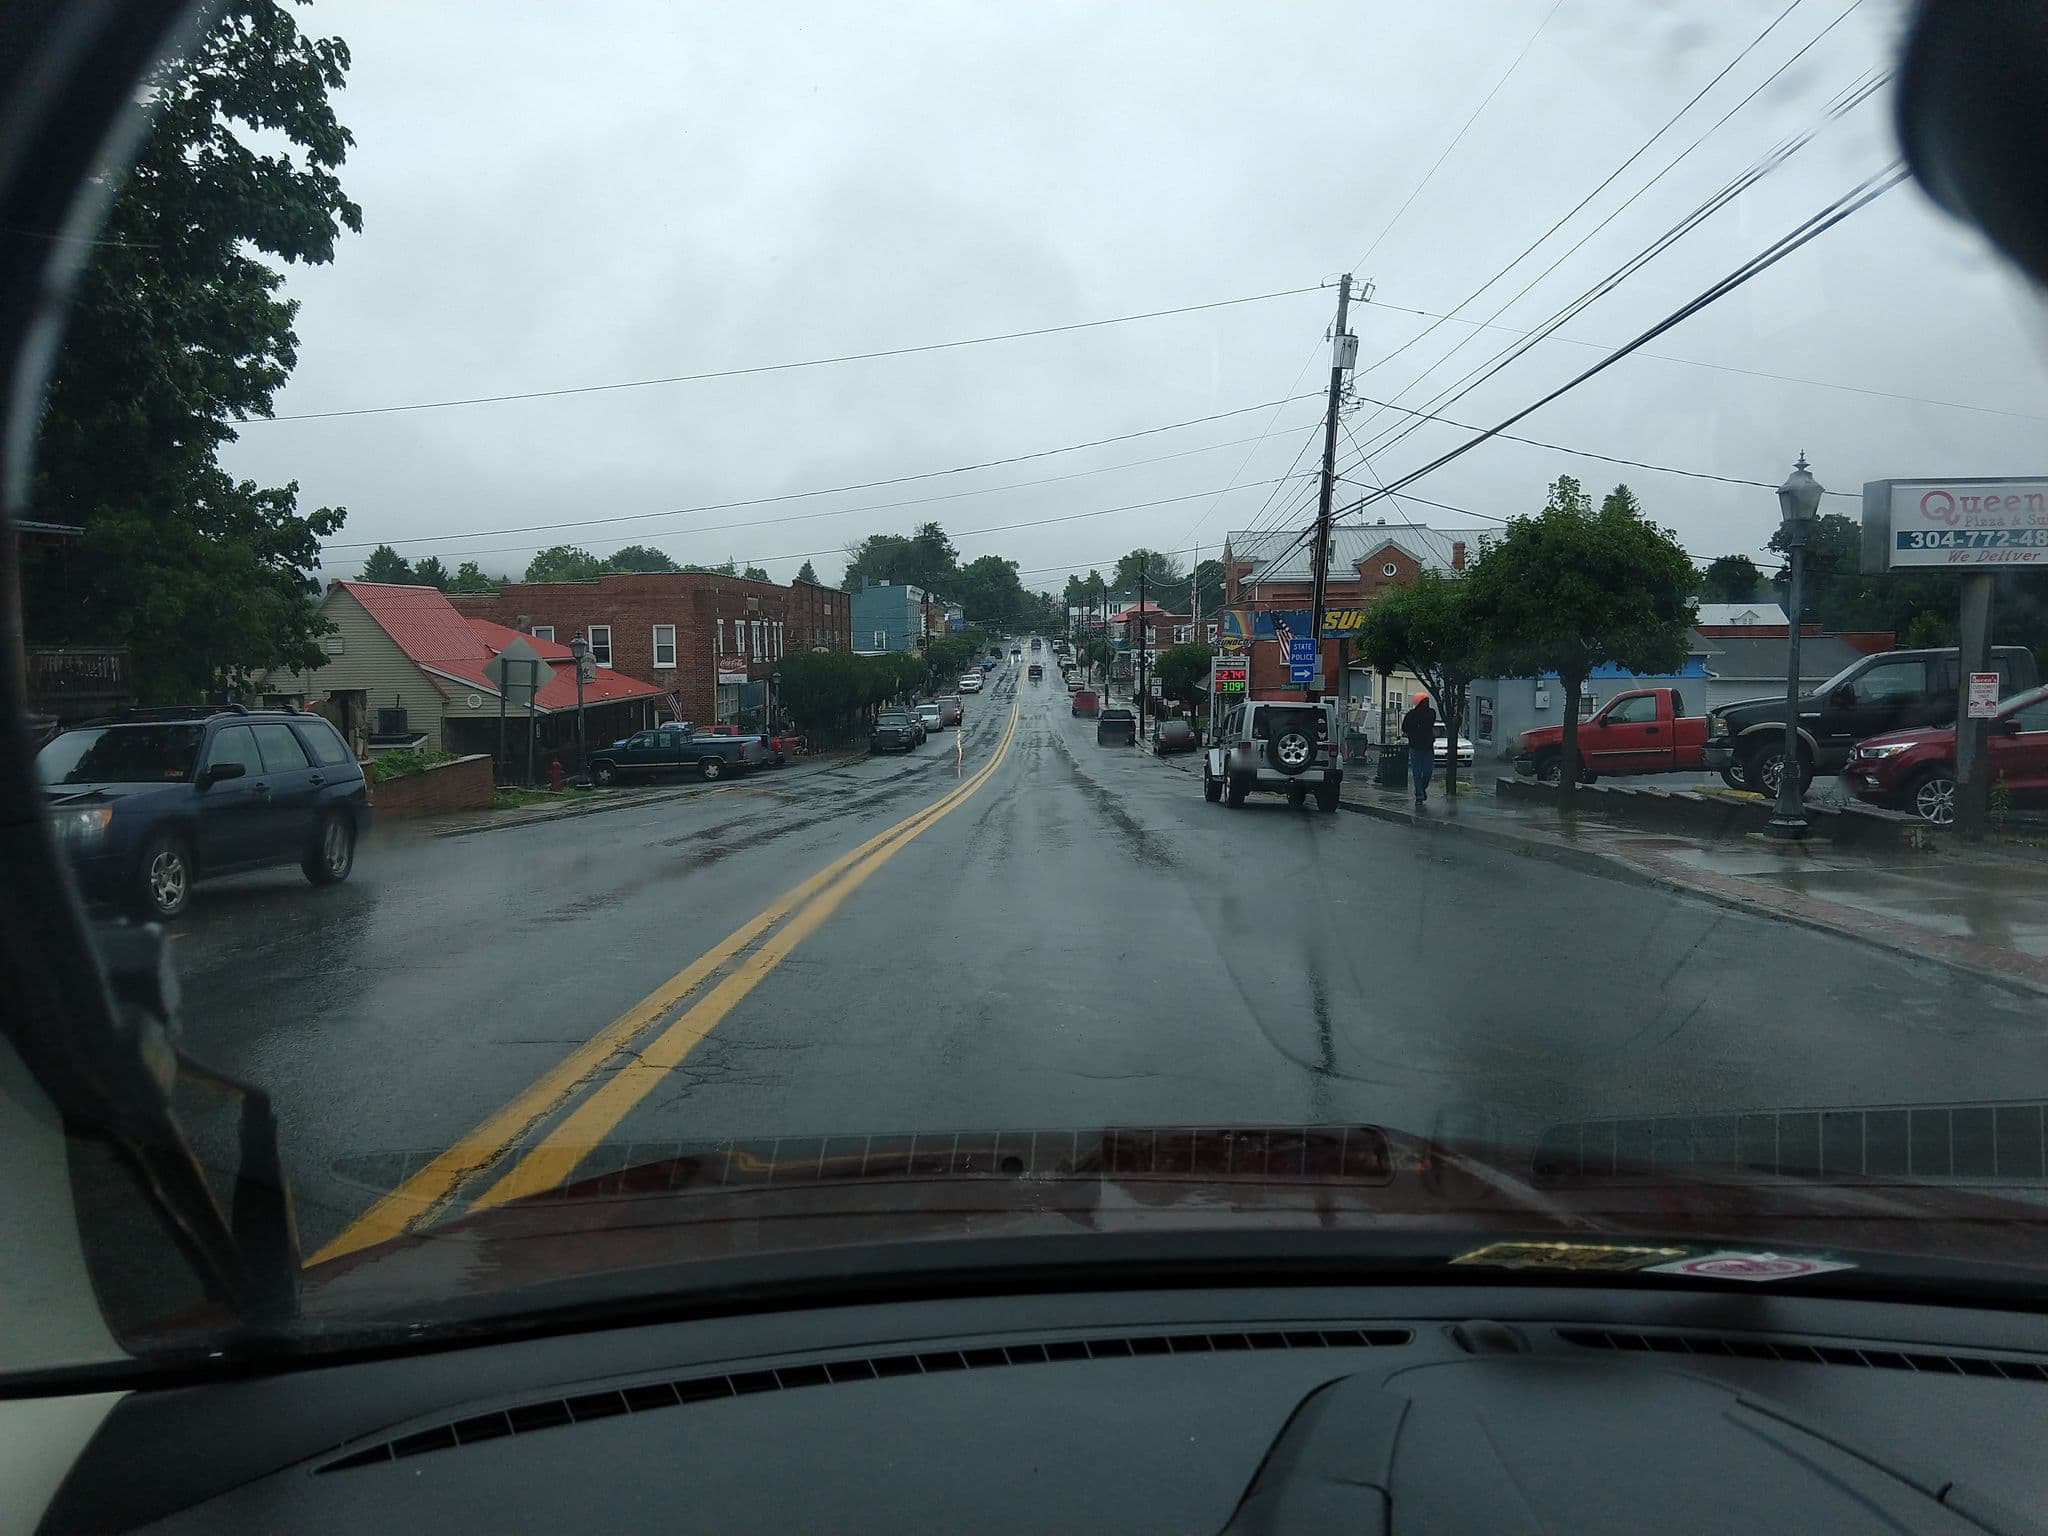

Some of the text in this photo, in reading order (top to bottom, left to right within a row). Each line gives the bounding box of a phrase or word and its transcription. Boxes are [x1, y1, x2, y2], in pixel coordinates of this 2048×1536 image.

[1965, 515, 2005, 528] Pizza
[1948, 550, 2041, 562] We Deliver
[1215, 639, 1252, 648] SUNOCO
[1291, 653, 1314, 661] POLICE
